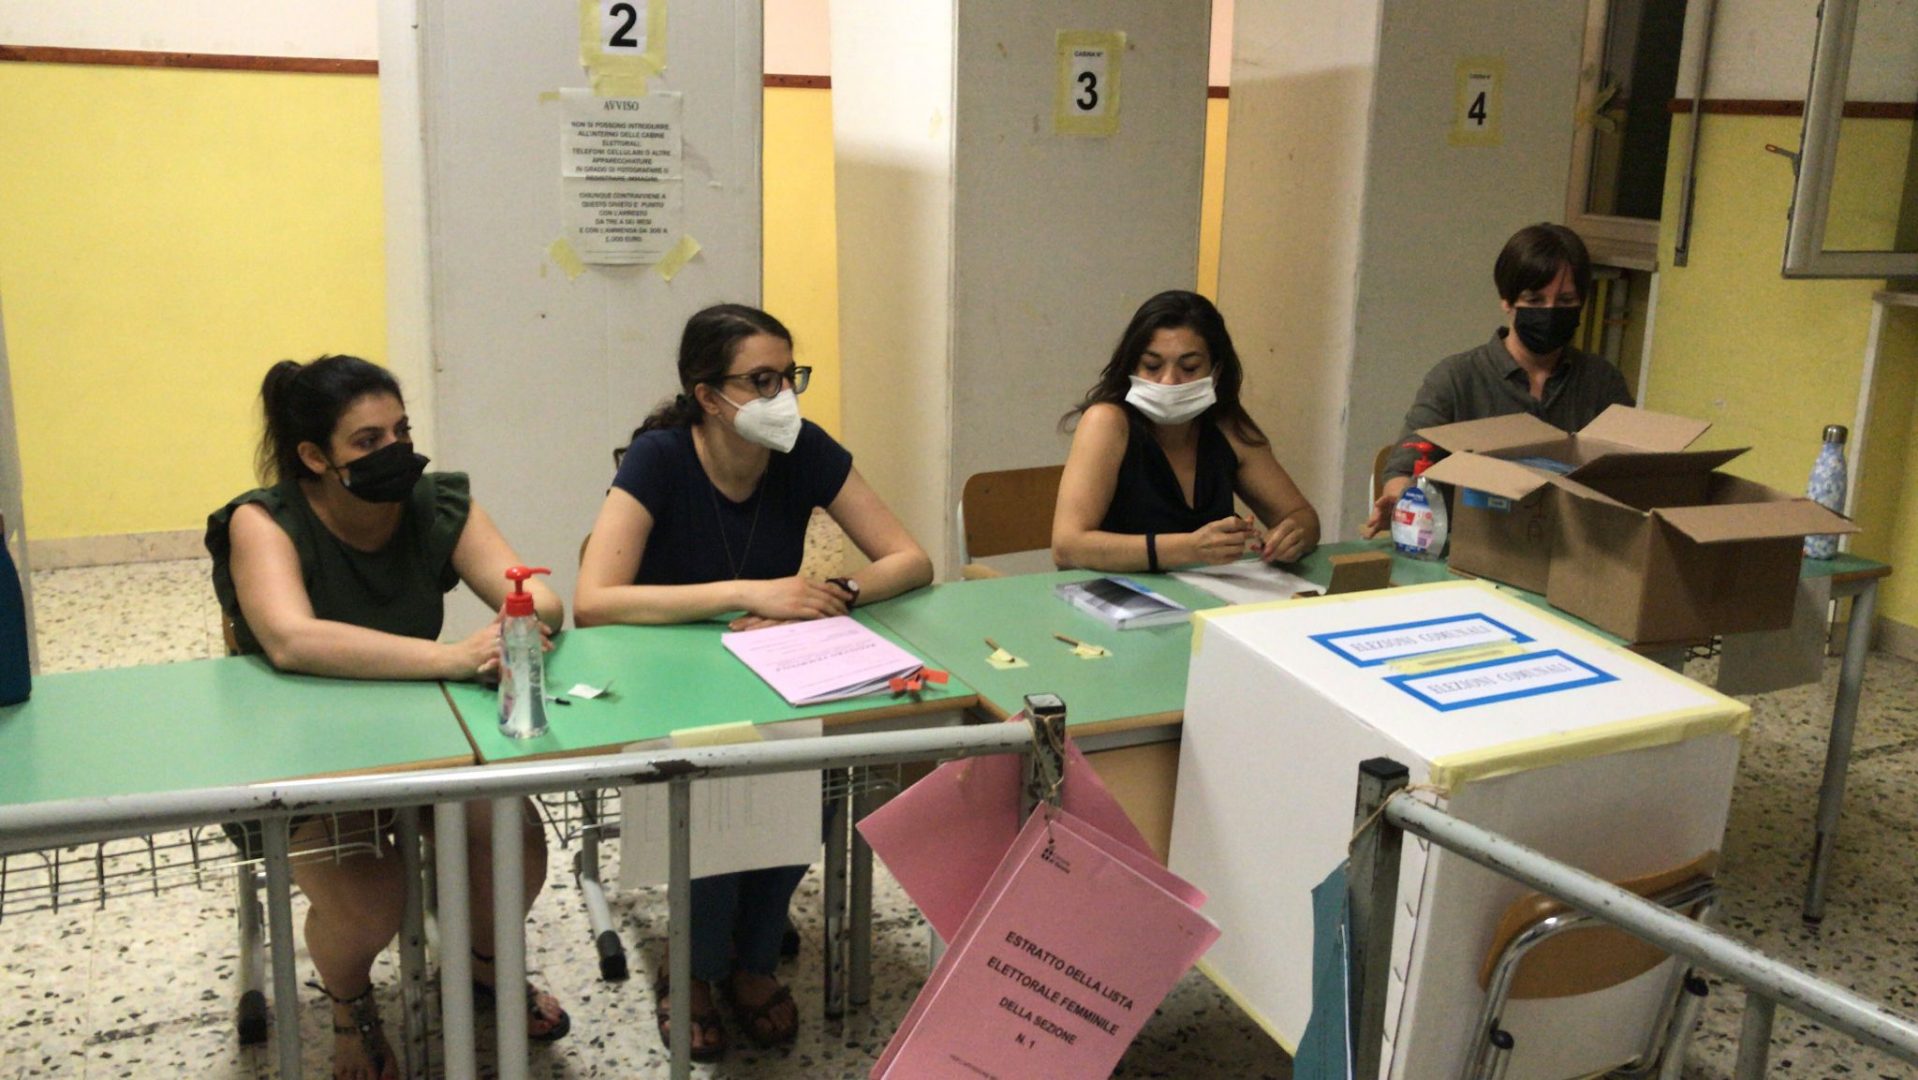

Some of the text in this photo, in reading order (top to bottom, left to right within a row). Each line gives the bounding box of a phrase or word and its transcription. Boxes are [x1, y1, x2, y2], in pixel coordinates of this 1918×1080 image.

[609, 3, 637, 47] 2
[603, 100, 639, 111] AVVISO
[1076, 71, 1098, 111] 3
[1468, 91, 1486, 126] 4
[1350, 624, 1492, 653] ELEZIONI COMUNALI
[1427, 662, 1572, 694] ELEZIONI COMUNALI
[1005, 930, 1134, 1012] ESTRATTO DELLA LISTA
[987, 956, 1120, 1037] ELETTORALE FEMMINILE
[998, 996, 1077, 1046] DELLA SEZIONE
[1015, 1032, 1036, 1050] N. 1
